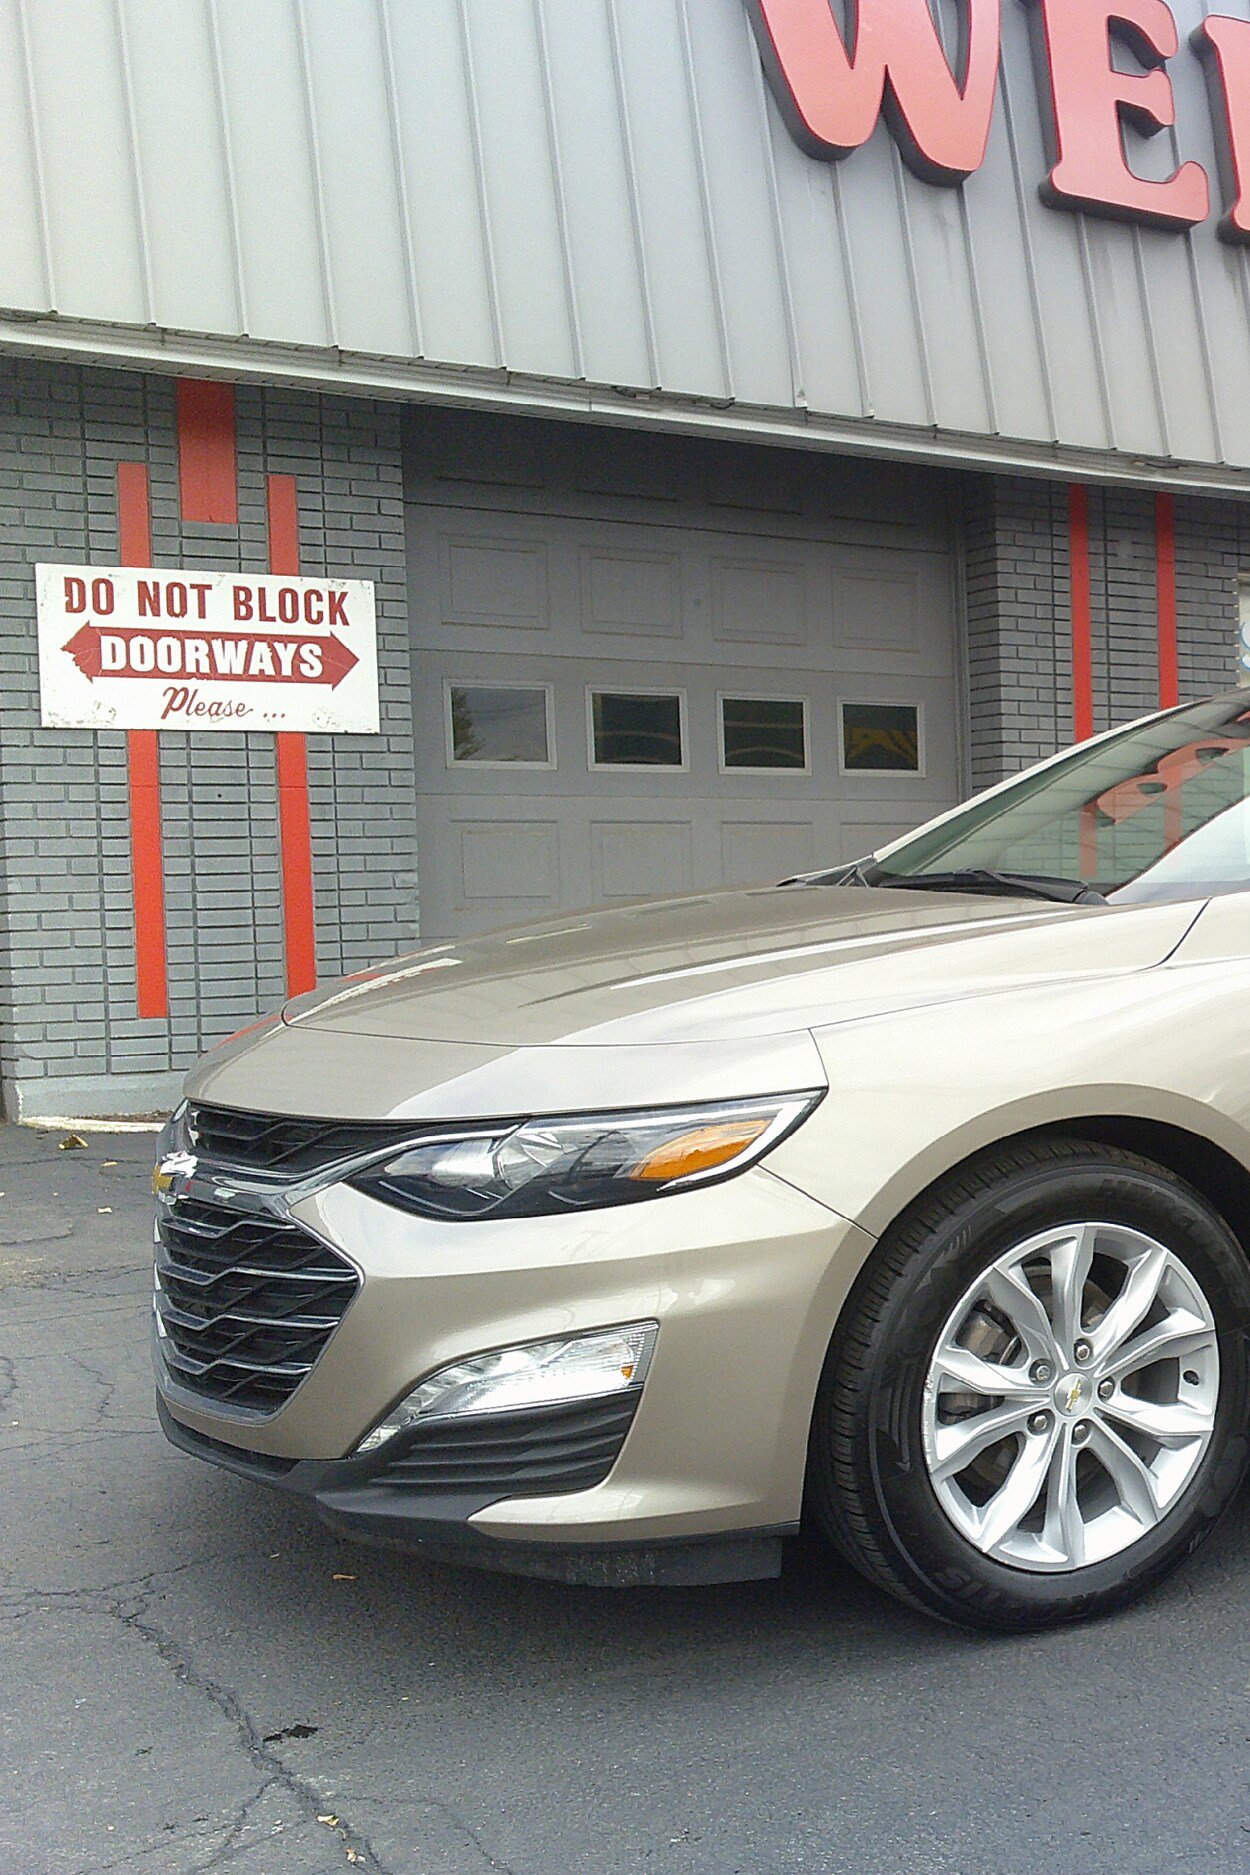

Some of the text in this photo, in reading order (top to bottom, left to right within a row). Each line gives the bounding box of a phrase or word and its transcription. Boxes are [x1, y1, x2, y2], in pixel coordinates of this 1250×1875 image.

[64, 577, 350, 626] DO NOT BLOCK
[101, 636, 324, 677] DOORWAYS
[160, 686, 253, 720] Please
